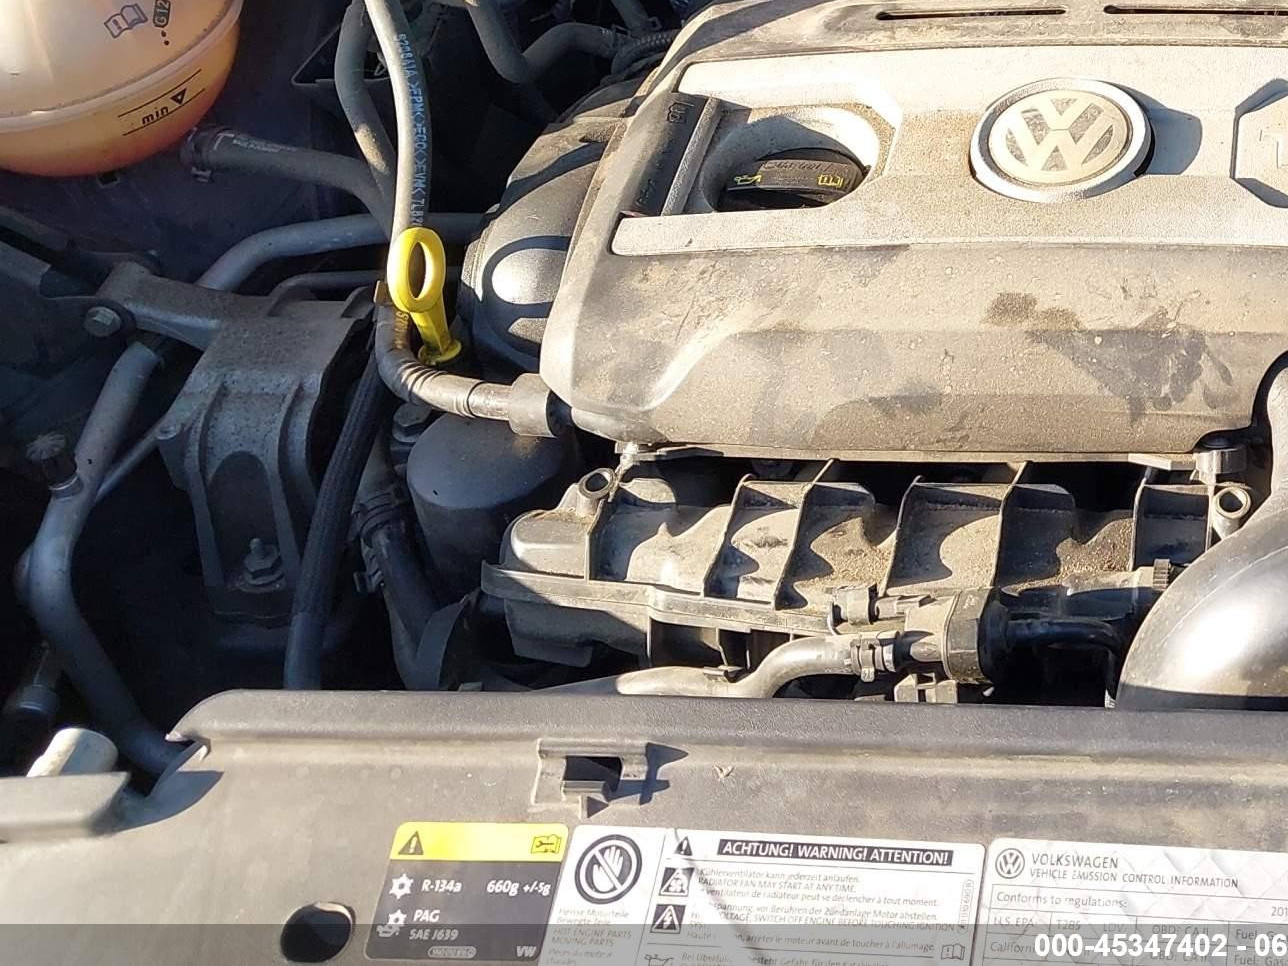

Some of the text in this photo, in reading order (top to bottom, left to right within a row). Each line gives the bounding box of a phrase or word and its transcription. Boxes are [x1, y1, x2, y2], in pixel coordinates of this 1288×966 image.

[155, 0, 170, 26] G12
[141, 105, 169, 125] min
[722, 841, 949, 864] ACHTUNG! WARNING! ATTENTION!
[1031, 852, 1120, 869] VOLKSWAGEN
[699, 877, 739, 887] RADIATOR
[740, 879, 756, 888] FAN
[758, 881, 776, 889] MAY
[778, 881, 802, 890] START
[804, 883, 814, 891] AT
[815, 883, 833, 891] ANY
[1030, 868, 1239, 888] VEHICLE EMISSION CONTROL INFORMATION
[420, 878, 463, 893] R-134a
[486, 879, 519, 896] 660g
[752, 890, 761, 898] de
[801, 893, 820, 903] peut
[884, 898, 900, 906] tout
[902, 898, 940, 906] moment.
[996, 891, 1048, 904] Conforms
[1050, 895, 1061, 904] to
[413, 908, 441, 923] PAG
[872, 910, 898, 920] Motor
[754, 914, 785, 924] SWITCH
[787, 916, 802, 925] OFF
[804, 917, 834, 927] ENGINE
[838, 918, 869, 928] BEFORE
[871, 920, 914, 930] TOUCHING
[915, 922, 955, 932] IGNITION
[408, 929, 459, 941] SAE J639
[552, 927, 632, 938] HOT ENGINE PARTS
[551, 936, 615, 947] MOVING PARTS
[784, 936, 814, 944] moteur
[815, 937, 838, 945] avant
[840, 938, 850, 946] de
[852, 939, 883, 948] toucher
[515, 945, 537, 957] VW
